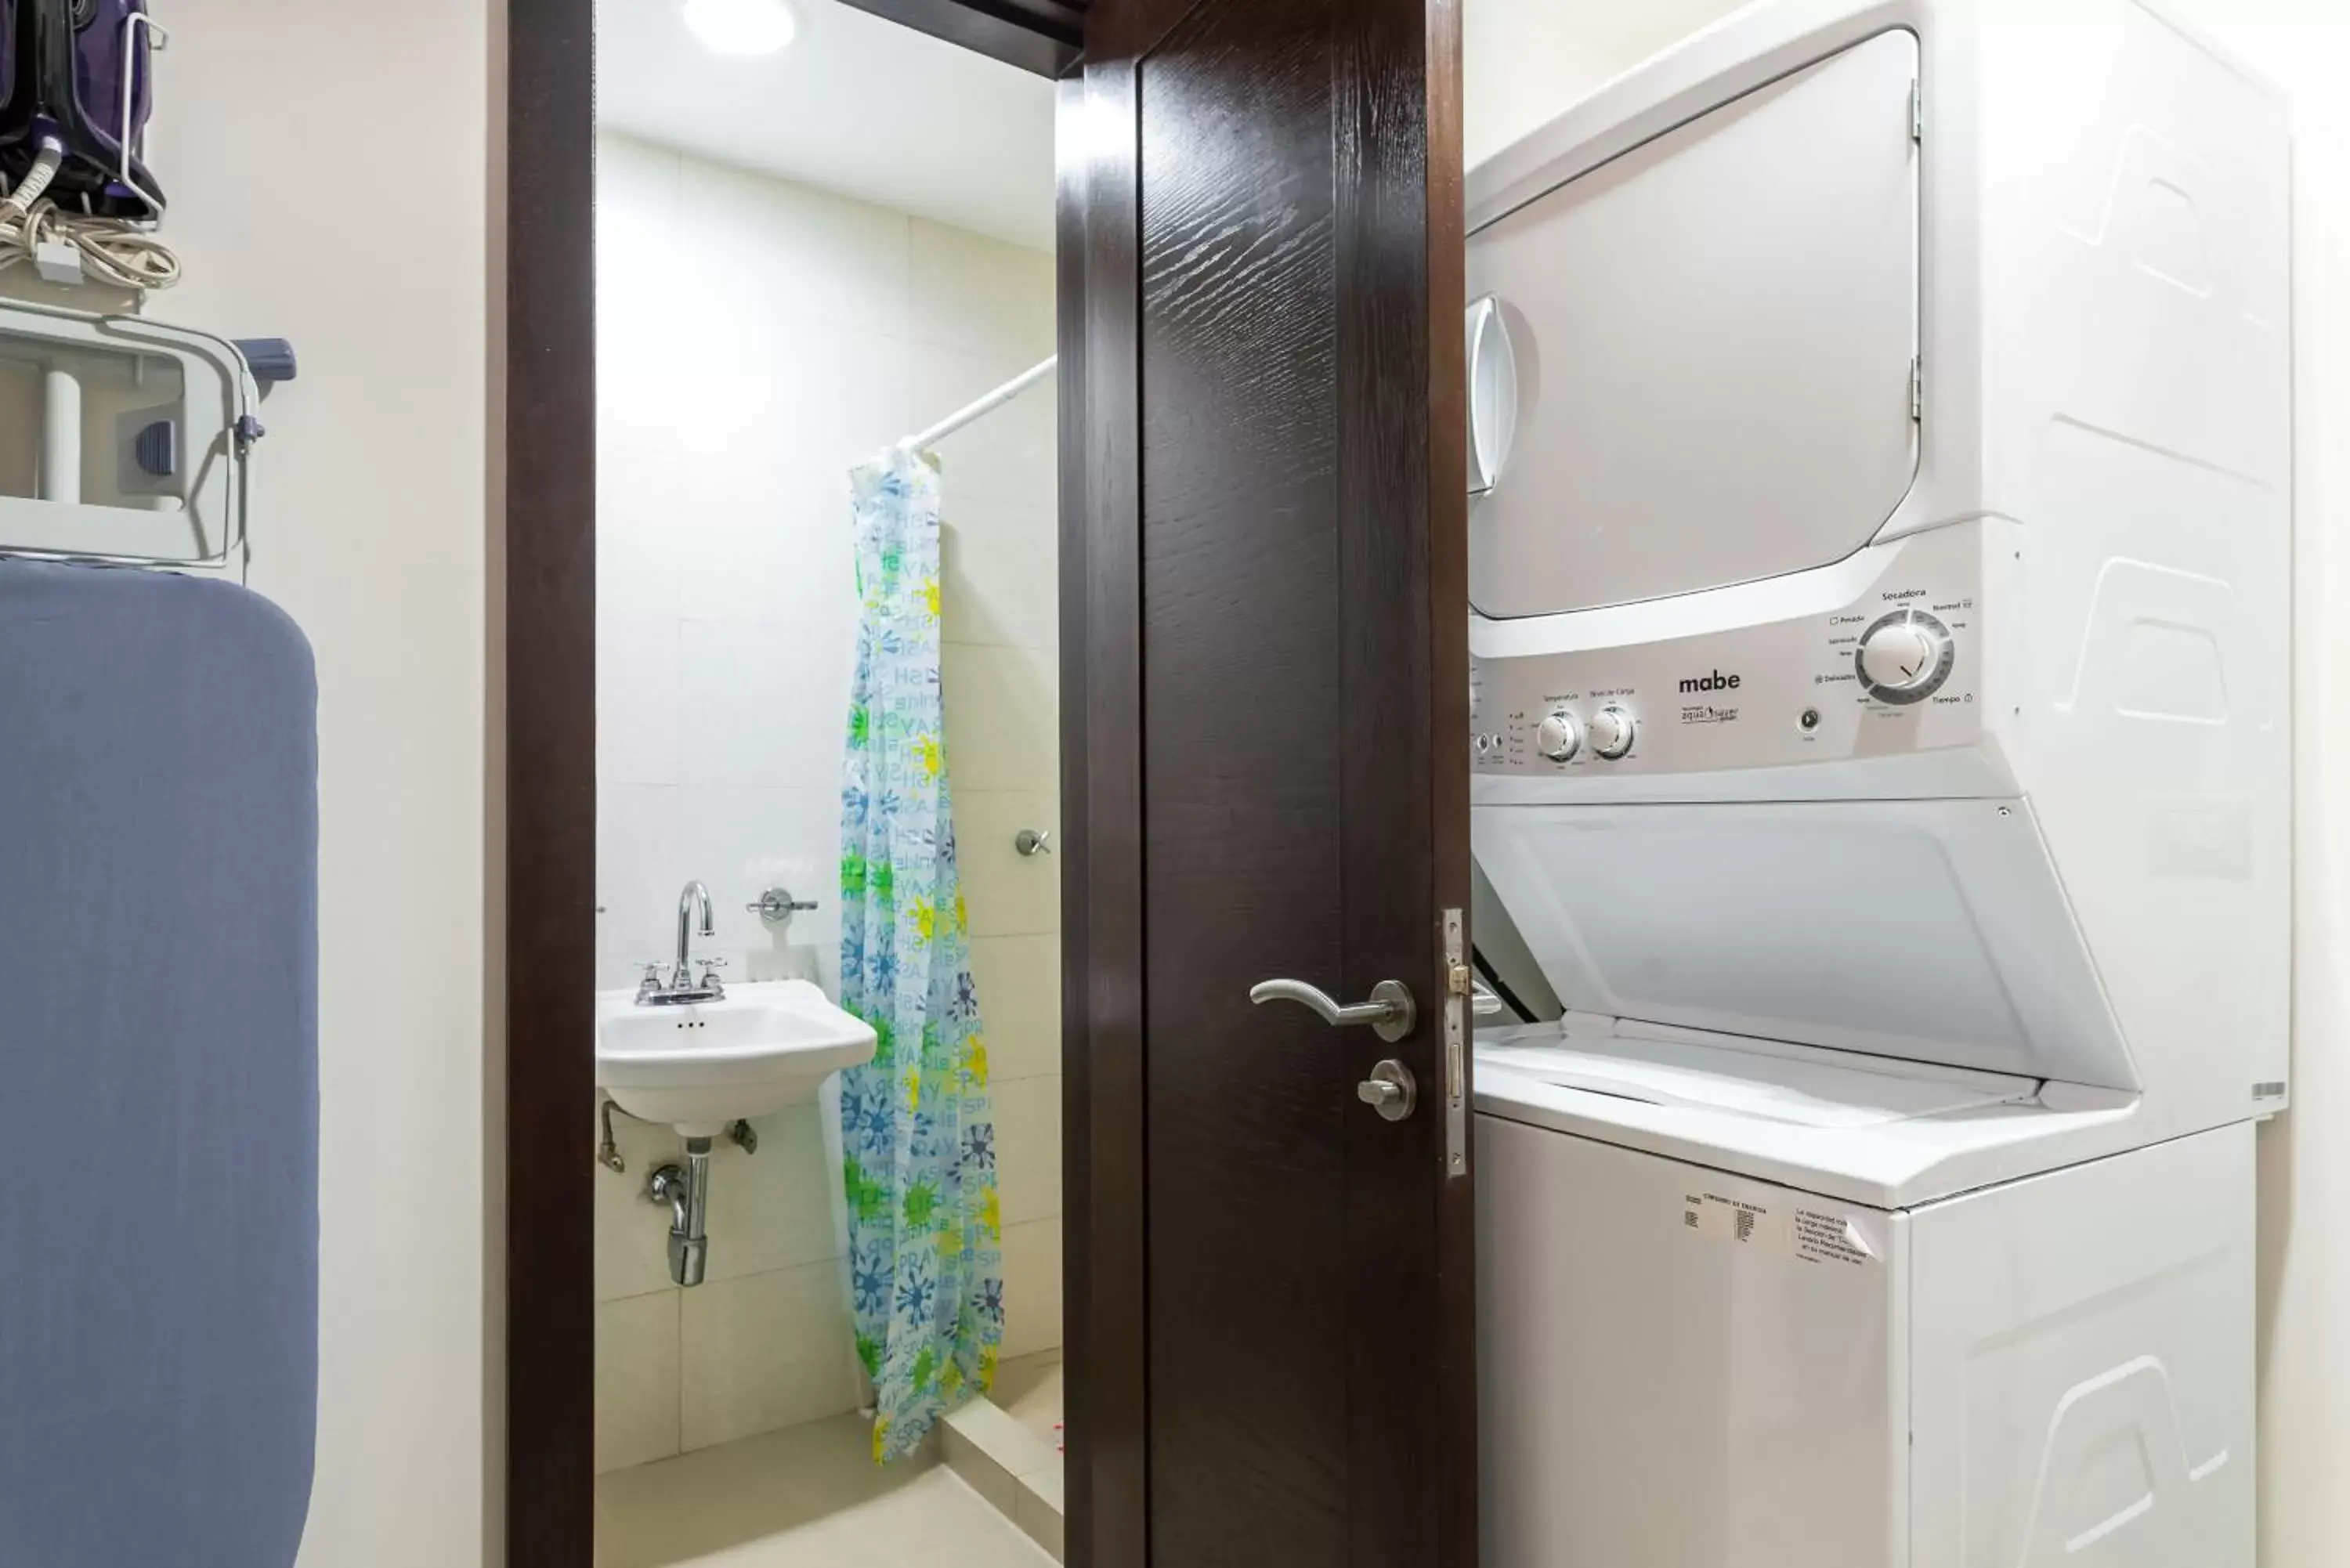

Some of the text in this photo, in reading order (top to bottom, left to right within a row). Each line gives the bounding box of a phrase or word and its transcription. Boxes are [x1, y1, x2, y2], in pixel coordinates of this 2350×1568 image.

[1882, 588, 1927, 602] Secadora
[1679, 668, 1741, 693] mabe
[1932, 696, 1961, 705] Tiempo
